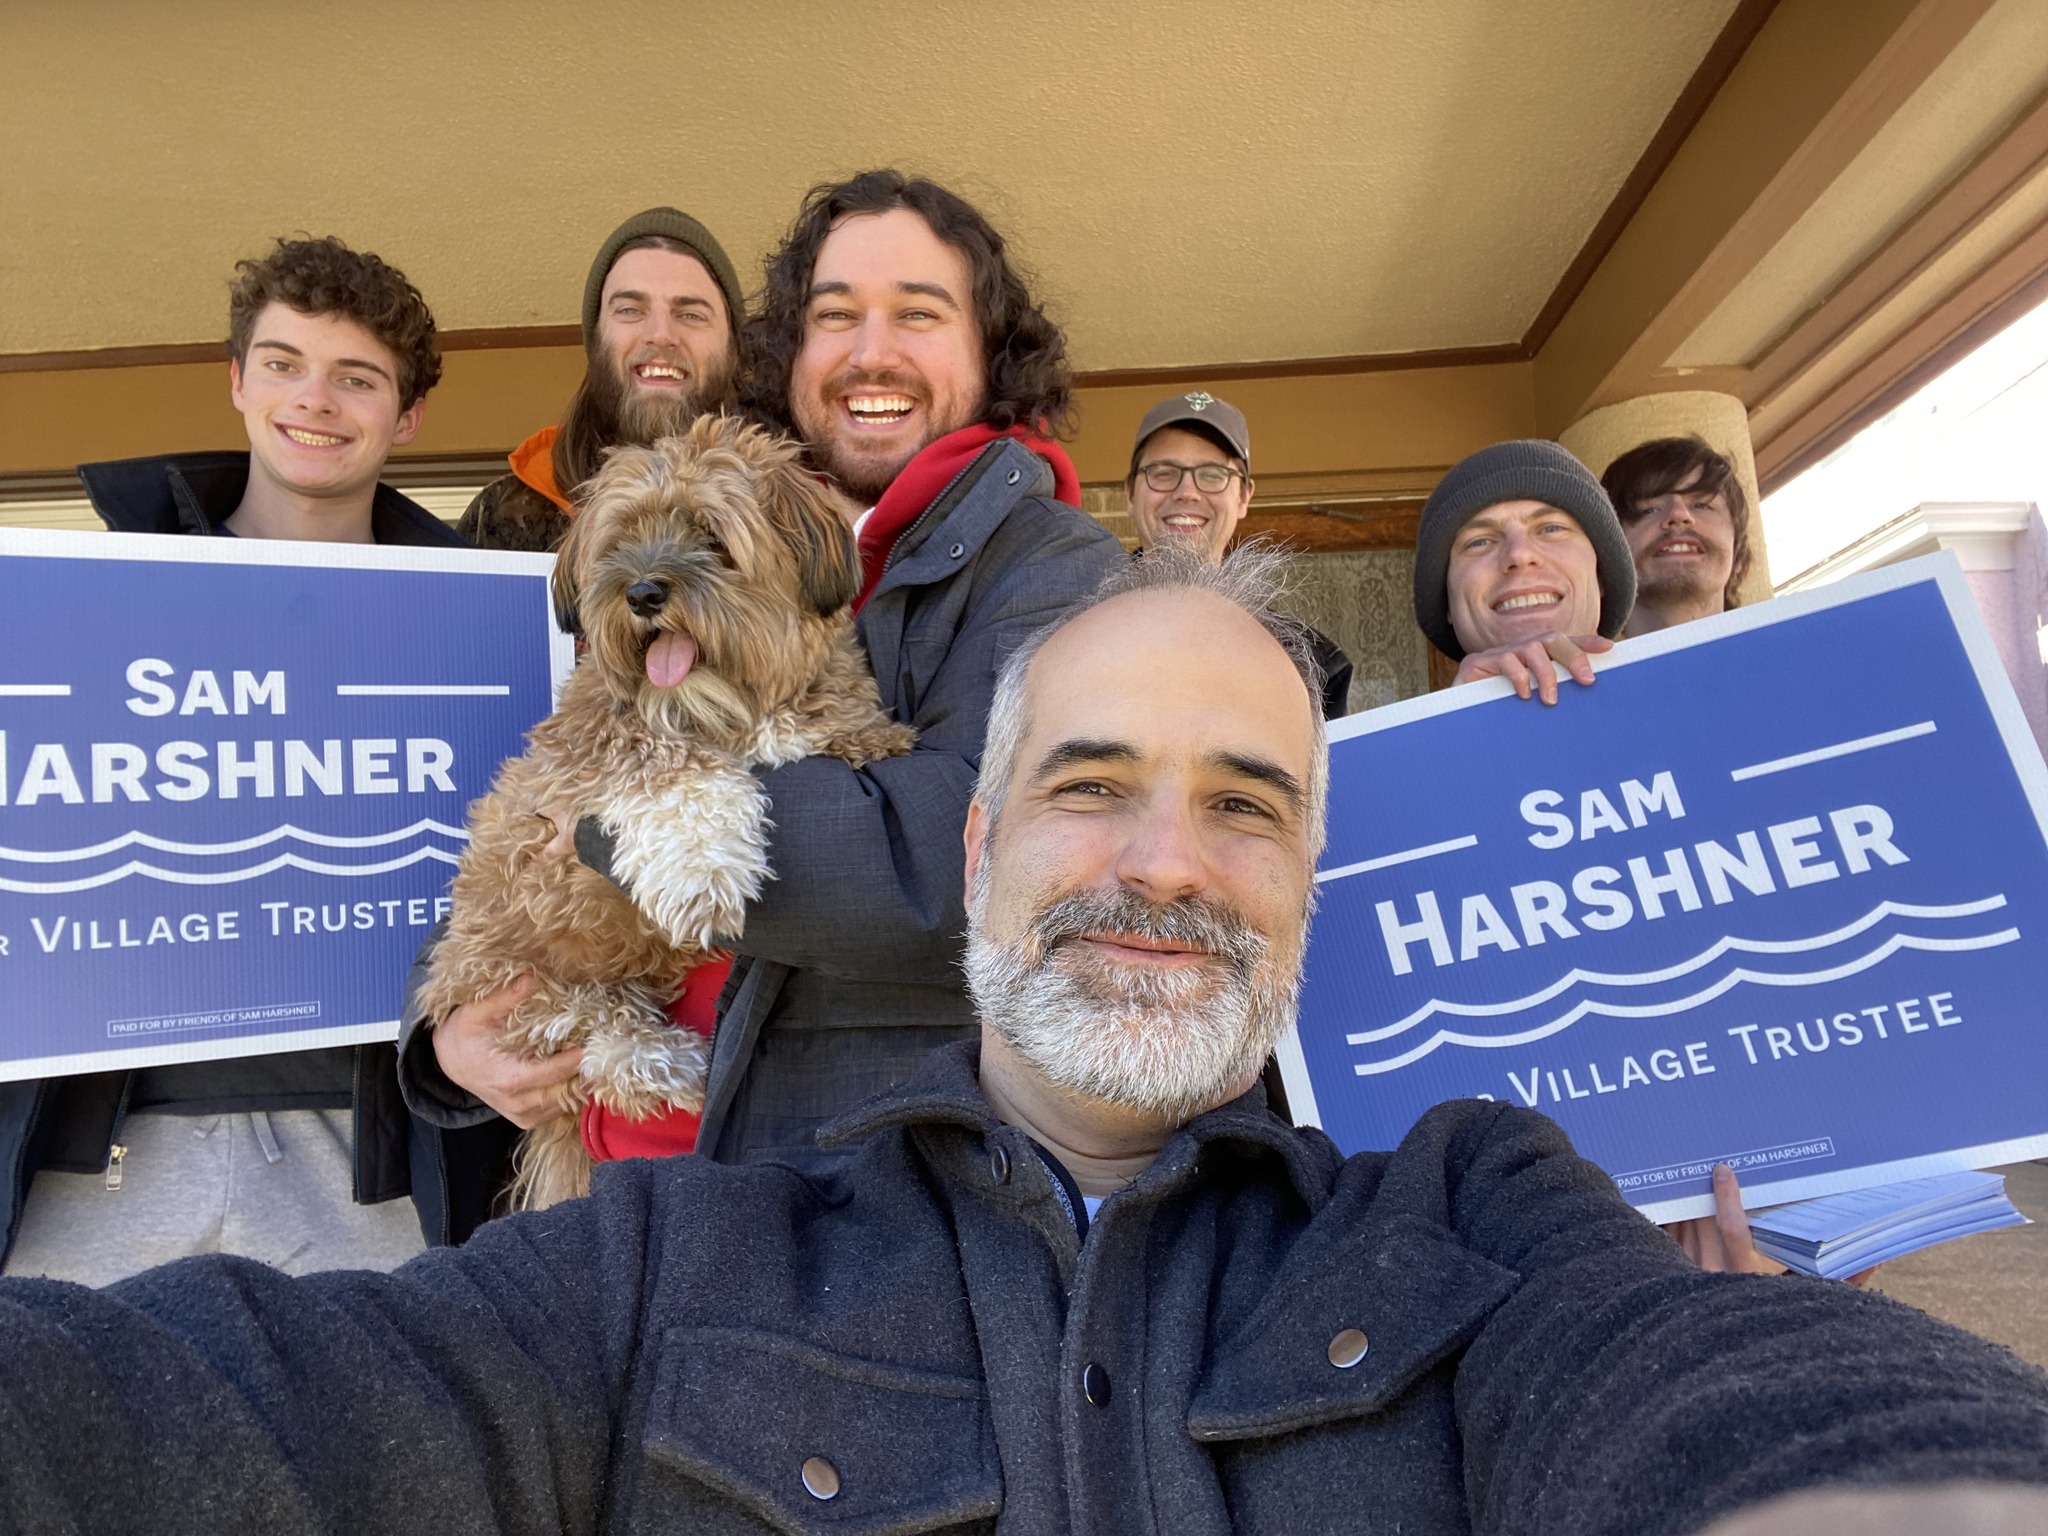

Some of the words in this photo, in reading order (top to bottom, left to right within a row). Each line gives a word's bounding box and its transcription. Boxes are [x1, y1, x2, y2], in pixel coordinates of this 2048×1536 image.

[125, 658, 286, 716] SAM
[0, 730, 457, 805] ARSHNER
[1519, 771, 1686, 849] SAM
[1375, 804, 1910, 975] HARSHNER
[30, 911, 240, 953] VILLAGE
[113, 1023, 138, 1033] PAID
[139, 1020, 160, 1031] FOR
[162, 1018, 176, 1028] BY
[178, 1014, 222, 1027] FRIENDS
[222, 1012, 237, 1023] OF
[238, 1009, 262, 1021] SAM
[262, 1004, 316, 1019] HARSHNER
[1507, 1042, 1716, 1107] VILLAGE
[1729, 992, 1962, 1065] TRUSTEE
[1617, 1176, 1642, 1190] PAID
[1642, 1171, 1665, 1185] FOR
[1665, 1167, 1681, 1181] BY
[1726, 1157, 1742, 1169] OF
[1743, 1152, 1768, 1167] SAM
[1769, 1141, 1829, 1162] HARSHNER
